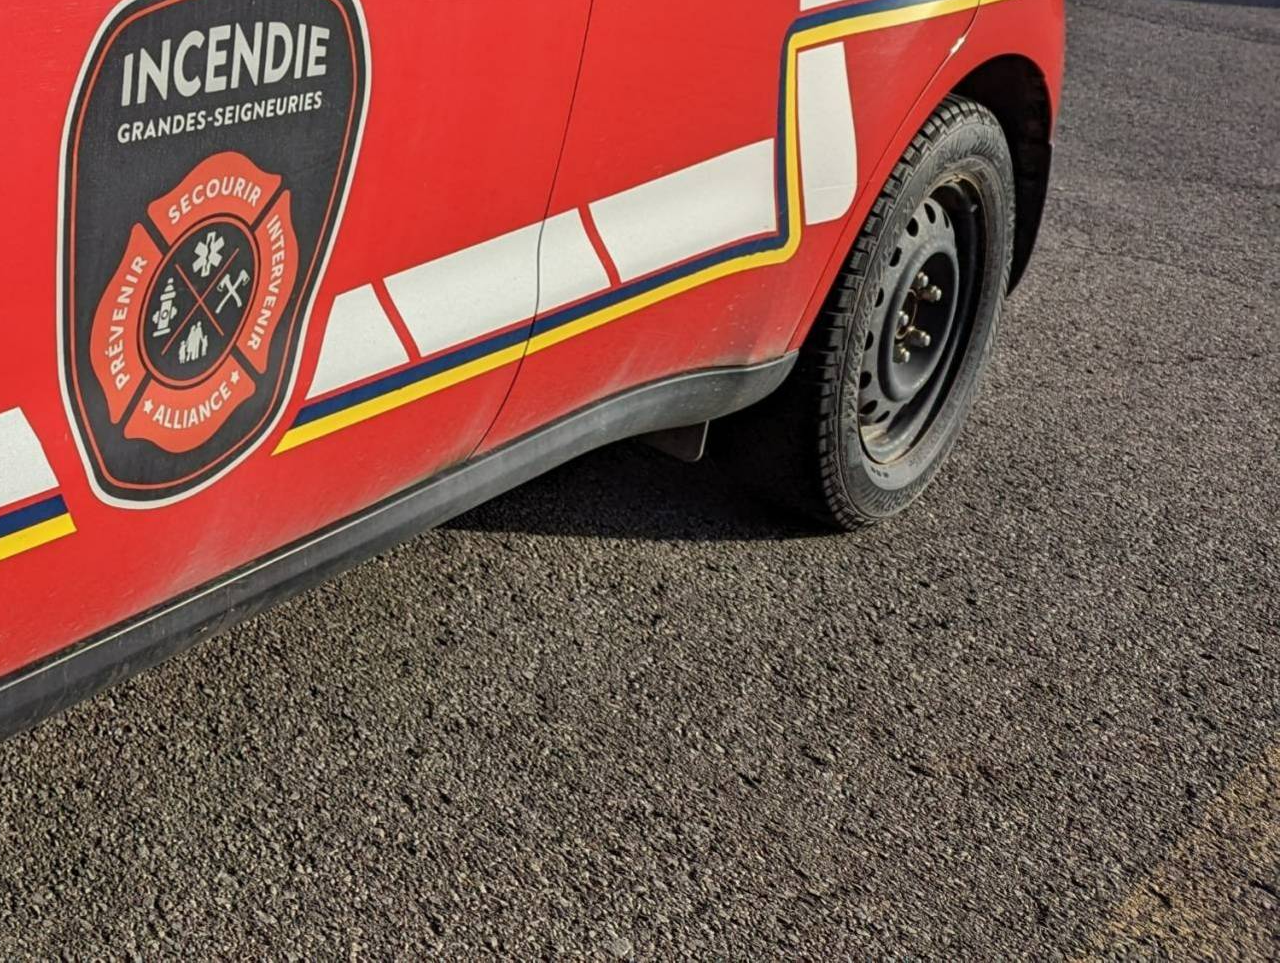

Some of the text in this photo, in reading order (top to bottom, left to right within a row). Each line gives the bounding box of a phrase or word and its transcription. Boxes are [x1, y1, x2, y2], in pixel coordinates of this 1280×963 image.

[121, 21, 330, 107] INCENDIE
[117, 91, 322, 143] GRANDES-SEIGNEURIES
[168, 176, 262, 224] SECOURIR
[247, 214, 286, 351] INTERVENIR
[105, 255, 148, 390] PRÉVENIR
[152, 382, 232, 429] ALLIANCE
